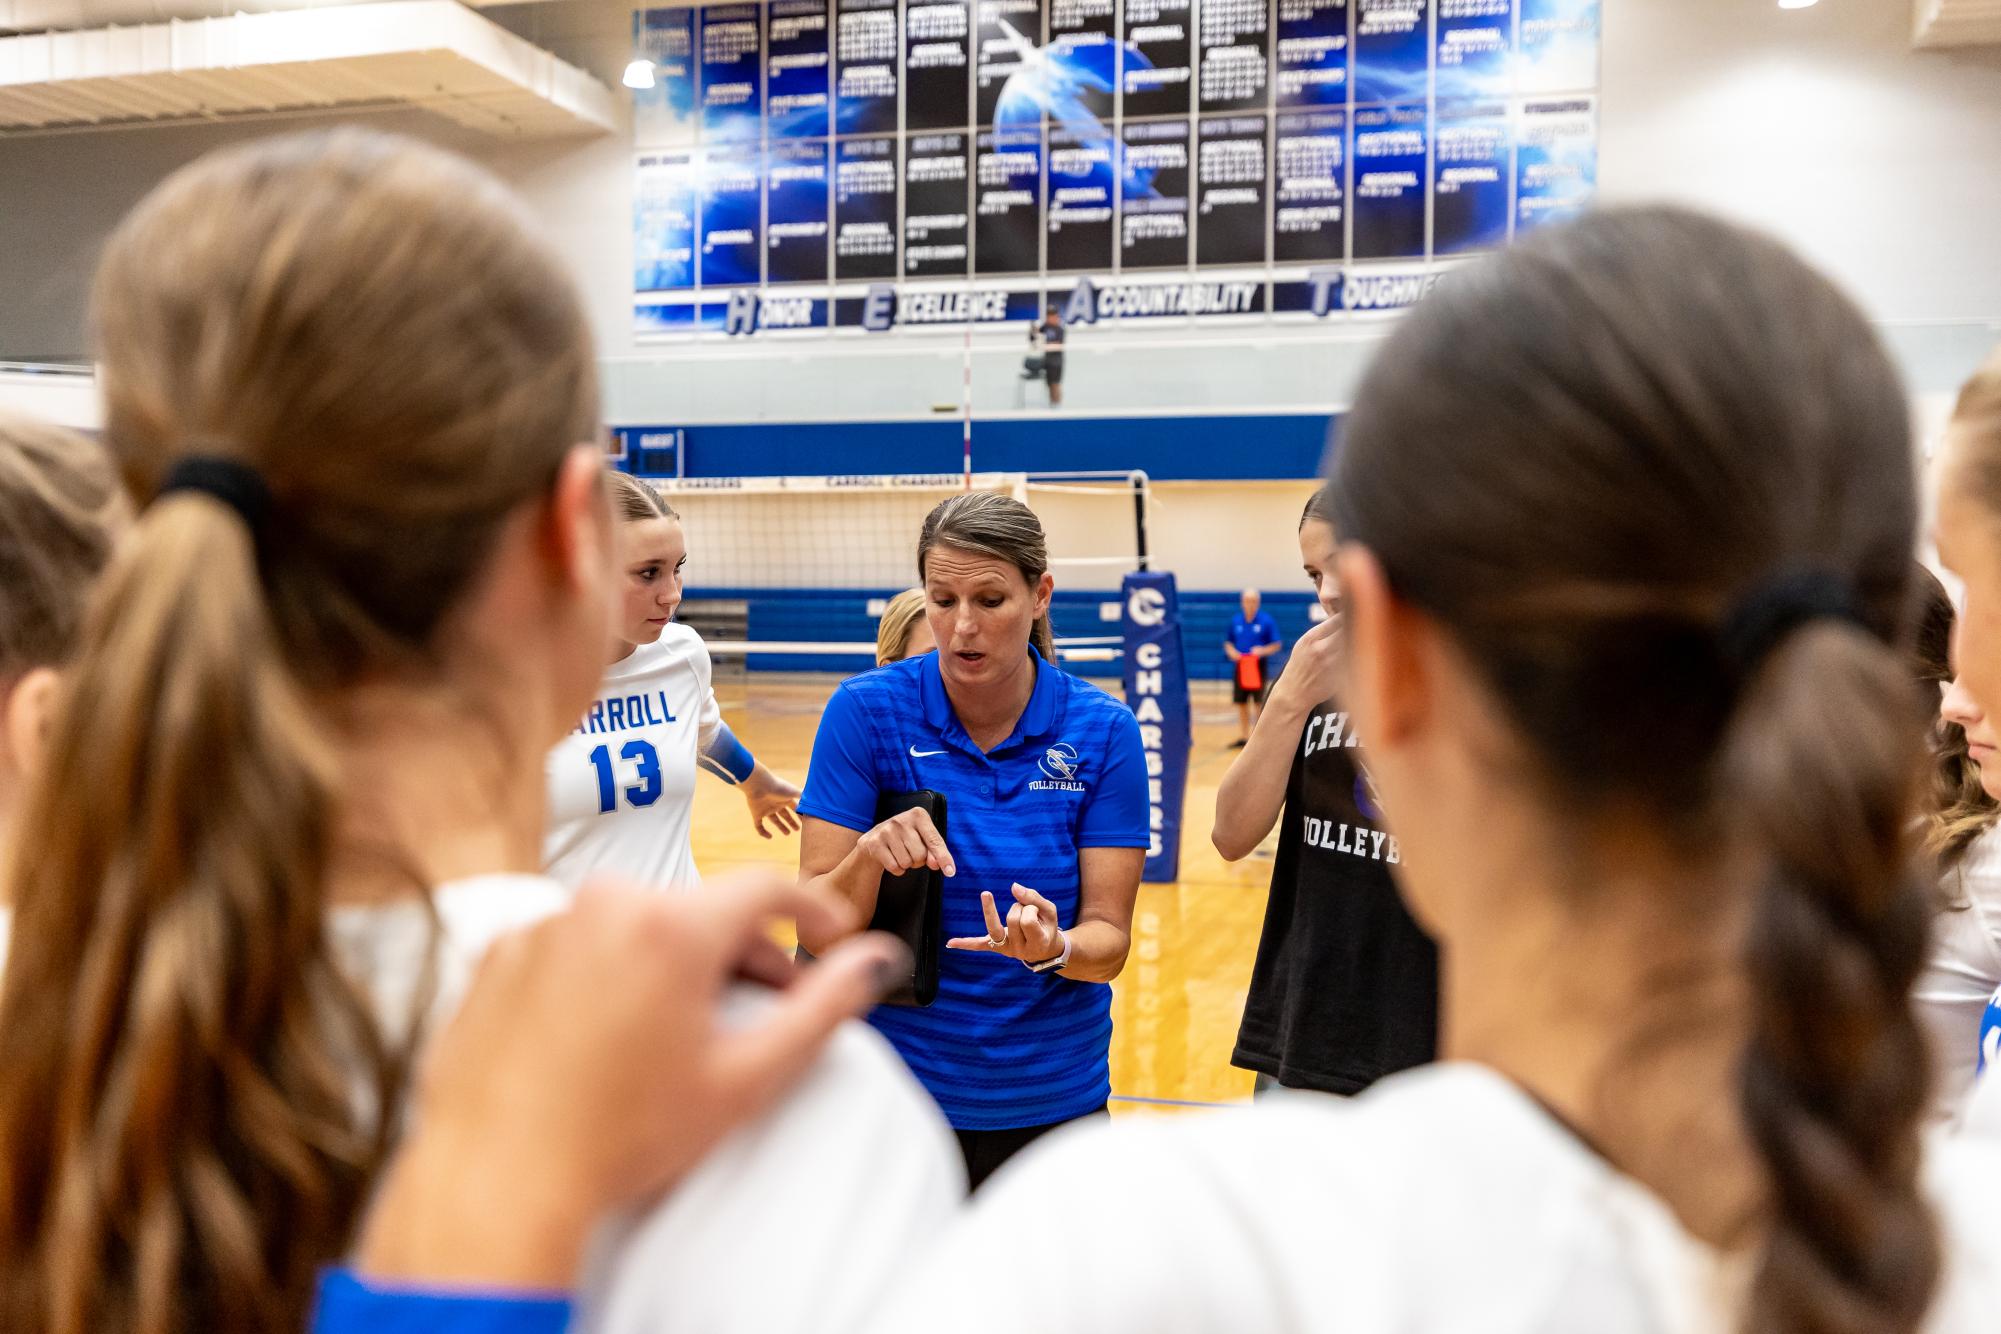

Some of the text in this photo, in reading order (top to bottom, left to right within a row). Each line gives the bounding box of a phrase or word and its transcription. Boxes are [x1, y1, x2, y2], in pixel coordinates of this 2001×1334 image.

[725, 288, 814, 335] HONOR
[863, 285, 1009, 331] EXCELLENCE
[1063, 276, 1259, 324] ACCOUNTABILITY
[1308, 269, 1444, 316] TOUGHNE
[588, 737, 664, 815] 13
[1028, 780, 1086, 792] VOLLEYBALL
